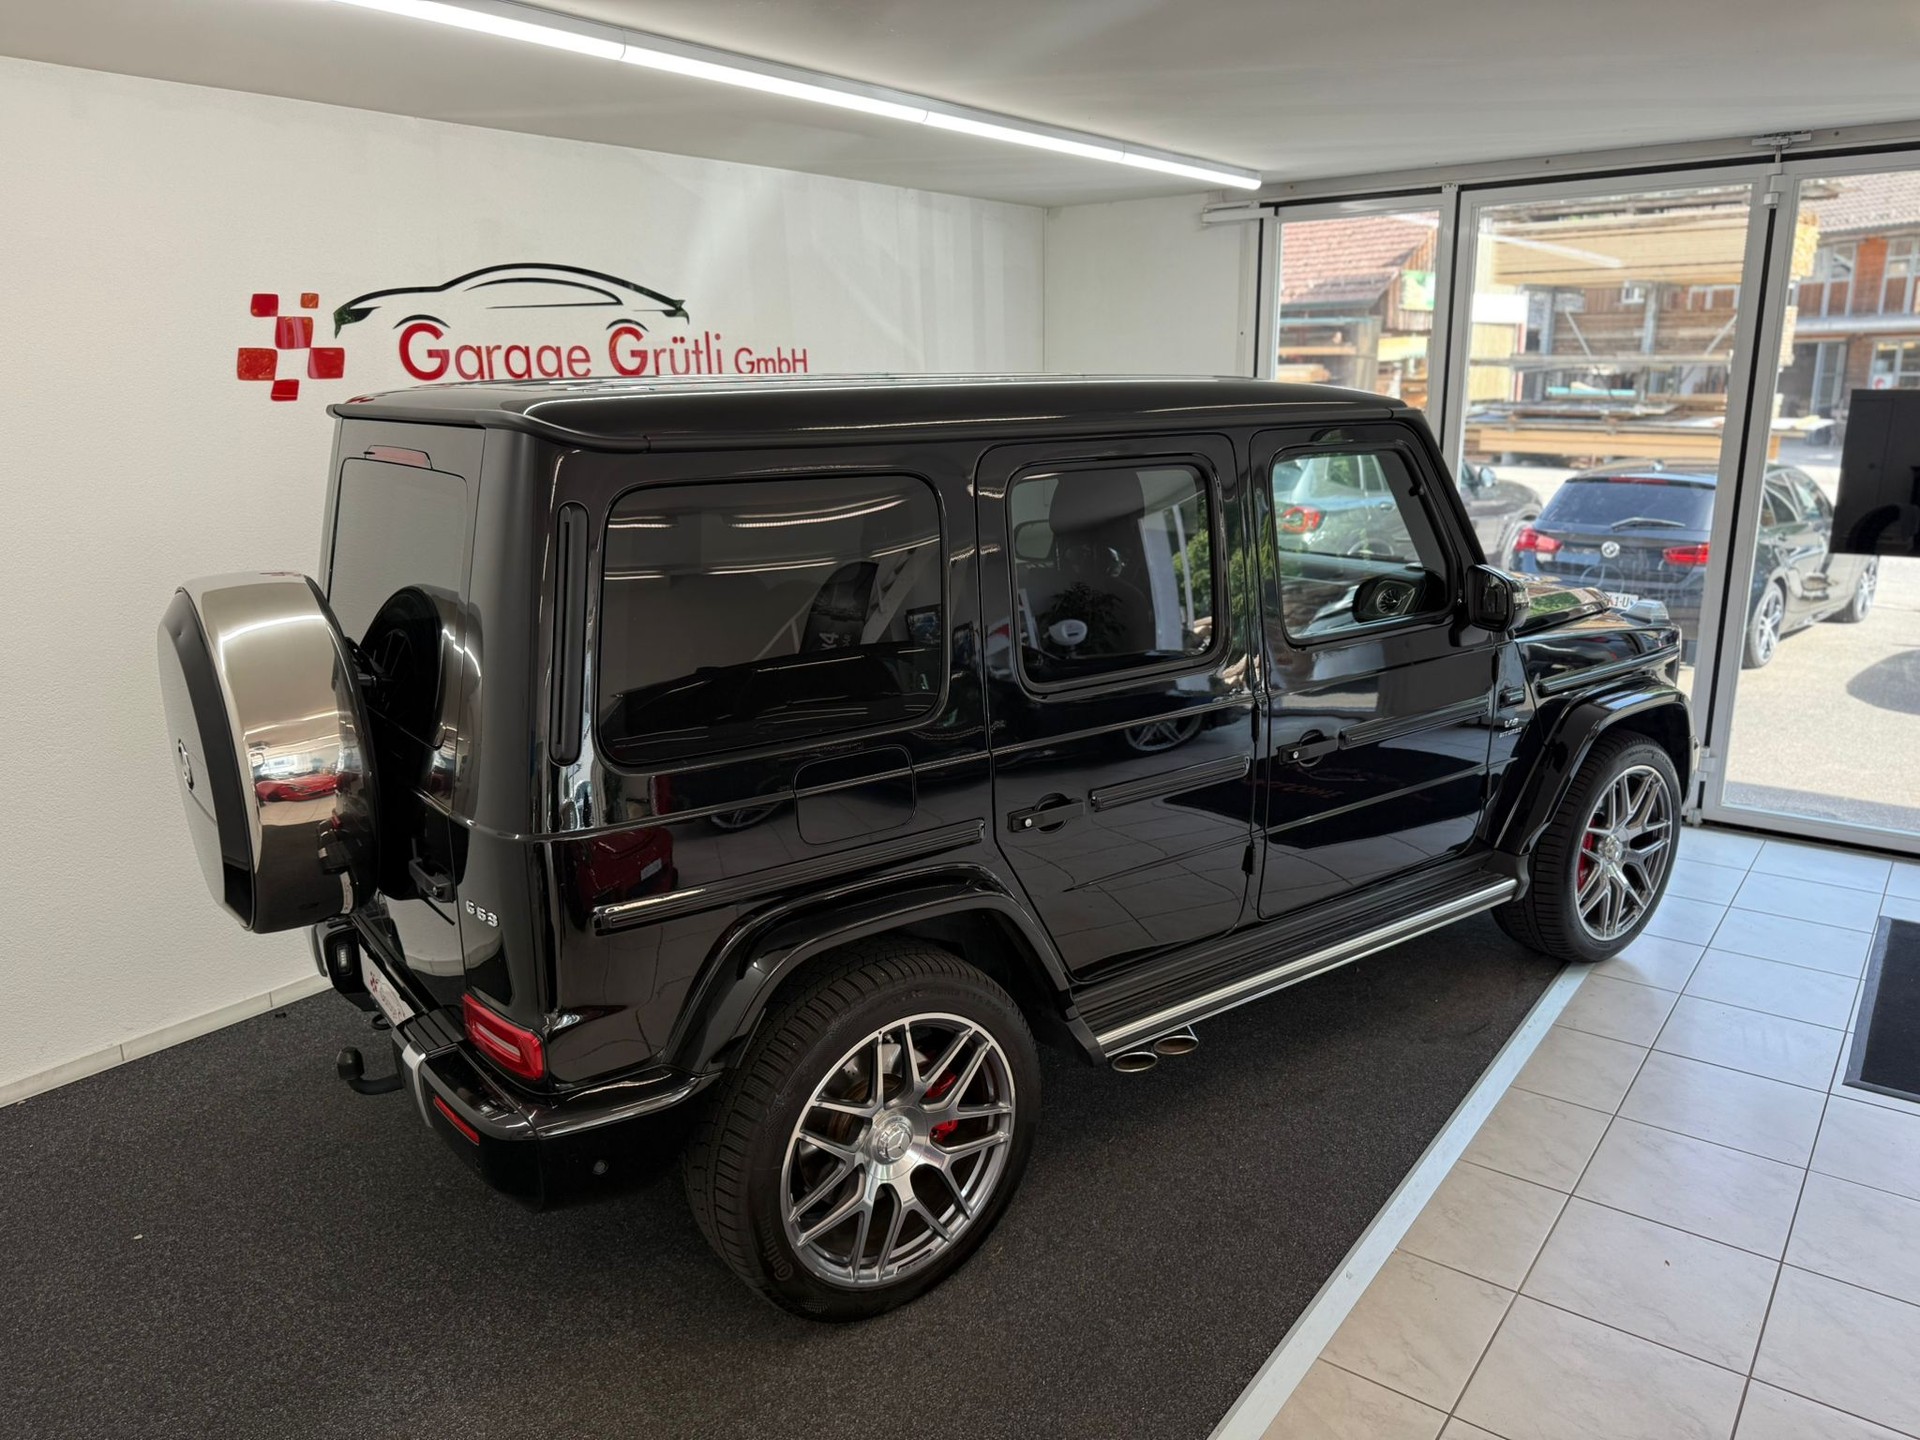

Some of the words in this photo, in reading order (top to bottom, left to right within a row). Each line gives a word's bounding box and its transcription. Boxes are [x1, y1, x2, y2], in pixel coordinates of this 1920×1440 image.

[399, 322, 592, 381] Garage
[608, 326, 723, 376] Grütli
[734, 347, 808, 374] GmbH
